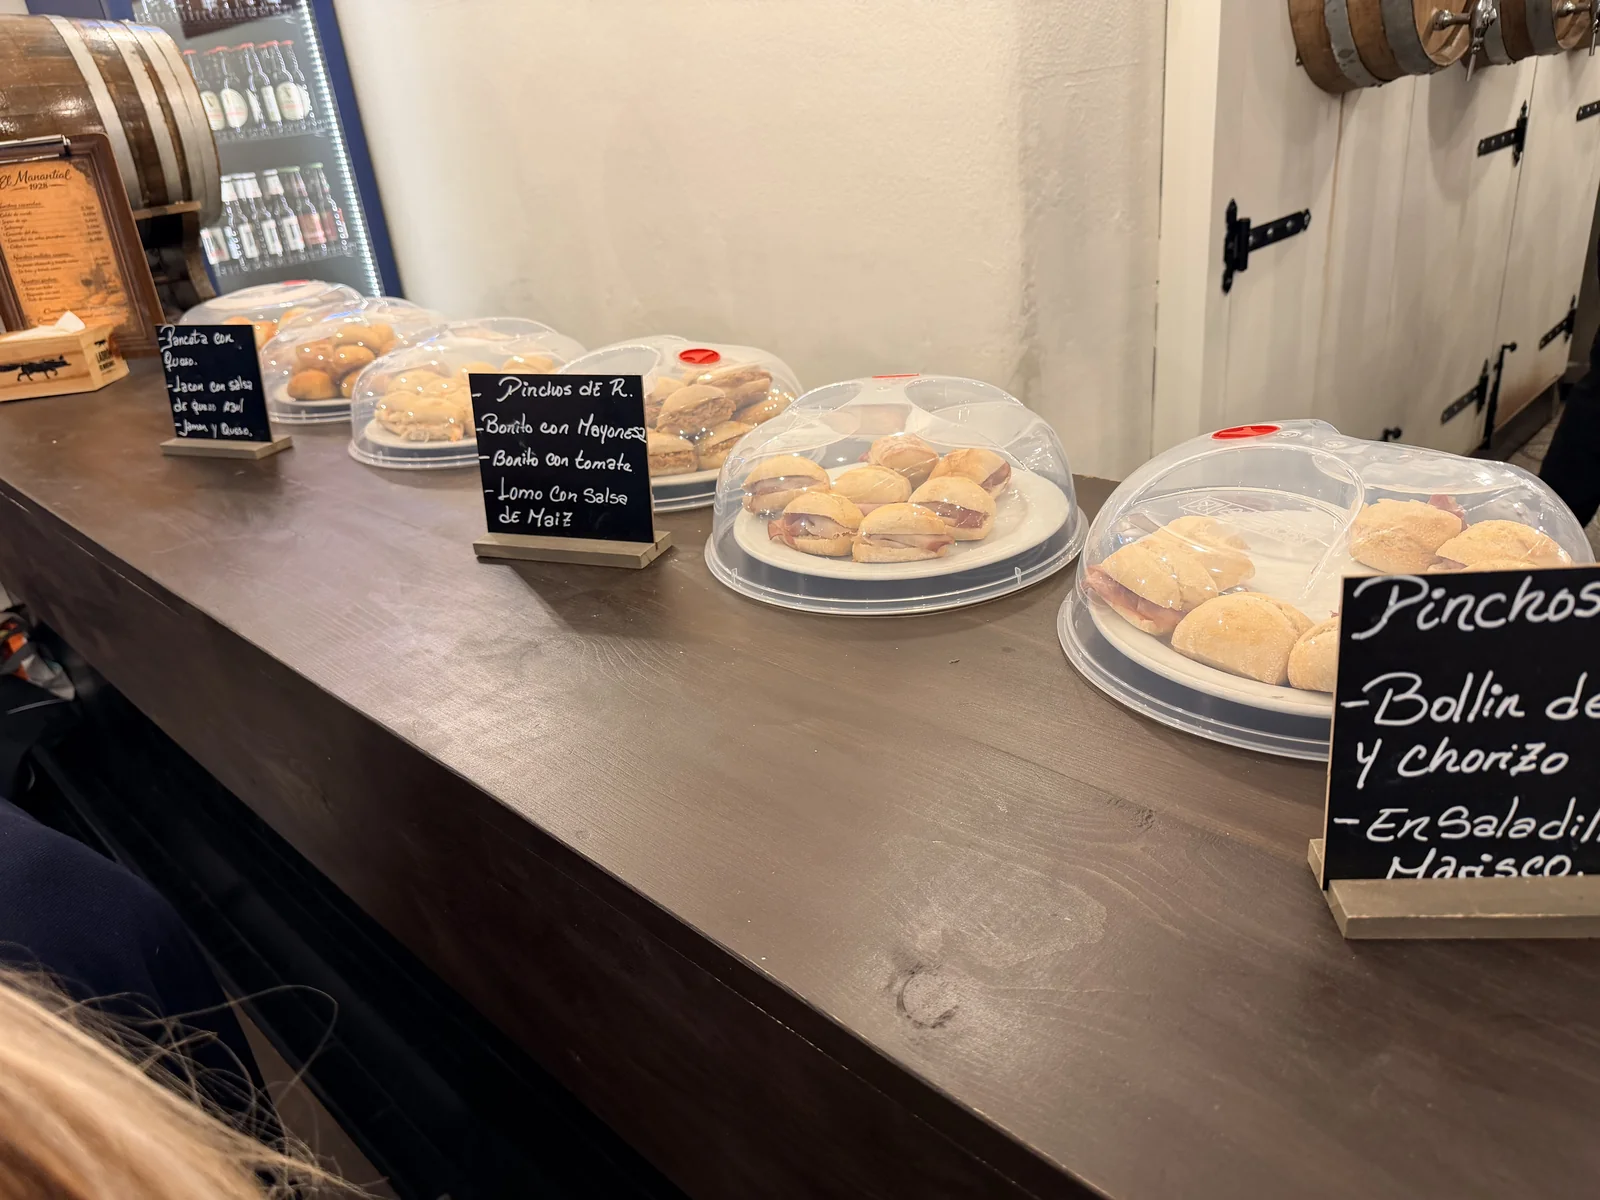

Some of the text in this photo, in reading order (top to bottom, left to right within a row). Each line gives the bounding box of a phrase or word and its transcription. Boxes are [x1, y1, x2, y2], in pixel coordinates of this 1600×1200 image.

[0, 168, 72, 190] El Manantial
[29, 182, 48, 190] 1928
[496, 376, 572, 402] Pinchos
[609, 378, 634, 397] R.
[539, 422, 569, 435] con
[577, 413, 647, 444] Mayonesa
[575, 450, 633, 472] tomate
[1351, 574, 1600, 640] Pinchos
[1545, 671, 1600, 721] de
